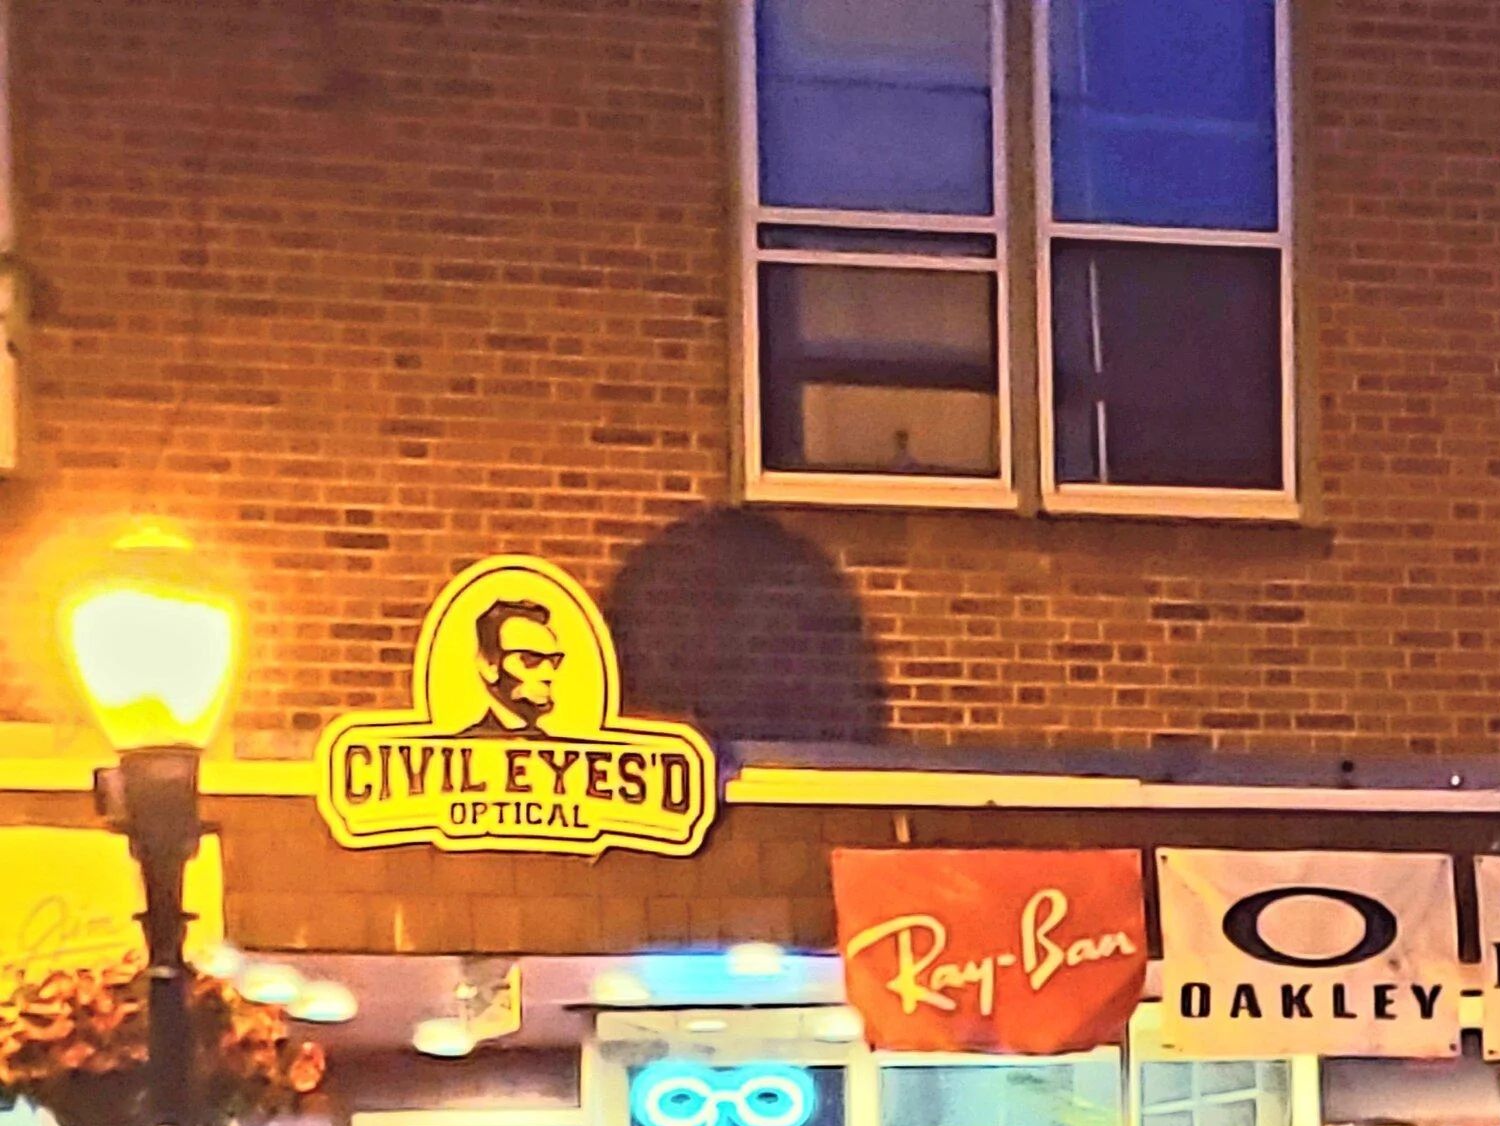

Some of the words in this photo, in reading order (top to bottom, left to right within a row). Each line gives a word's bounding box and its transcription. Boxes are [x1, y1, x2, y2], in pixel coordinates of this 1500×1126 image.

[344, 745, 487, 801] CIVIL
[505, 749, 691, 814] EYES'D
[449, 801, 590, 828] OPTICAL
[847, 888, 1137, 1016] Ray-Ban
[1180, 982, 1443, 1020] OAKLEY
